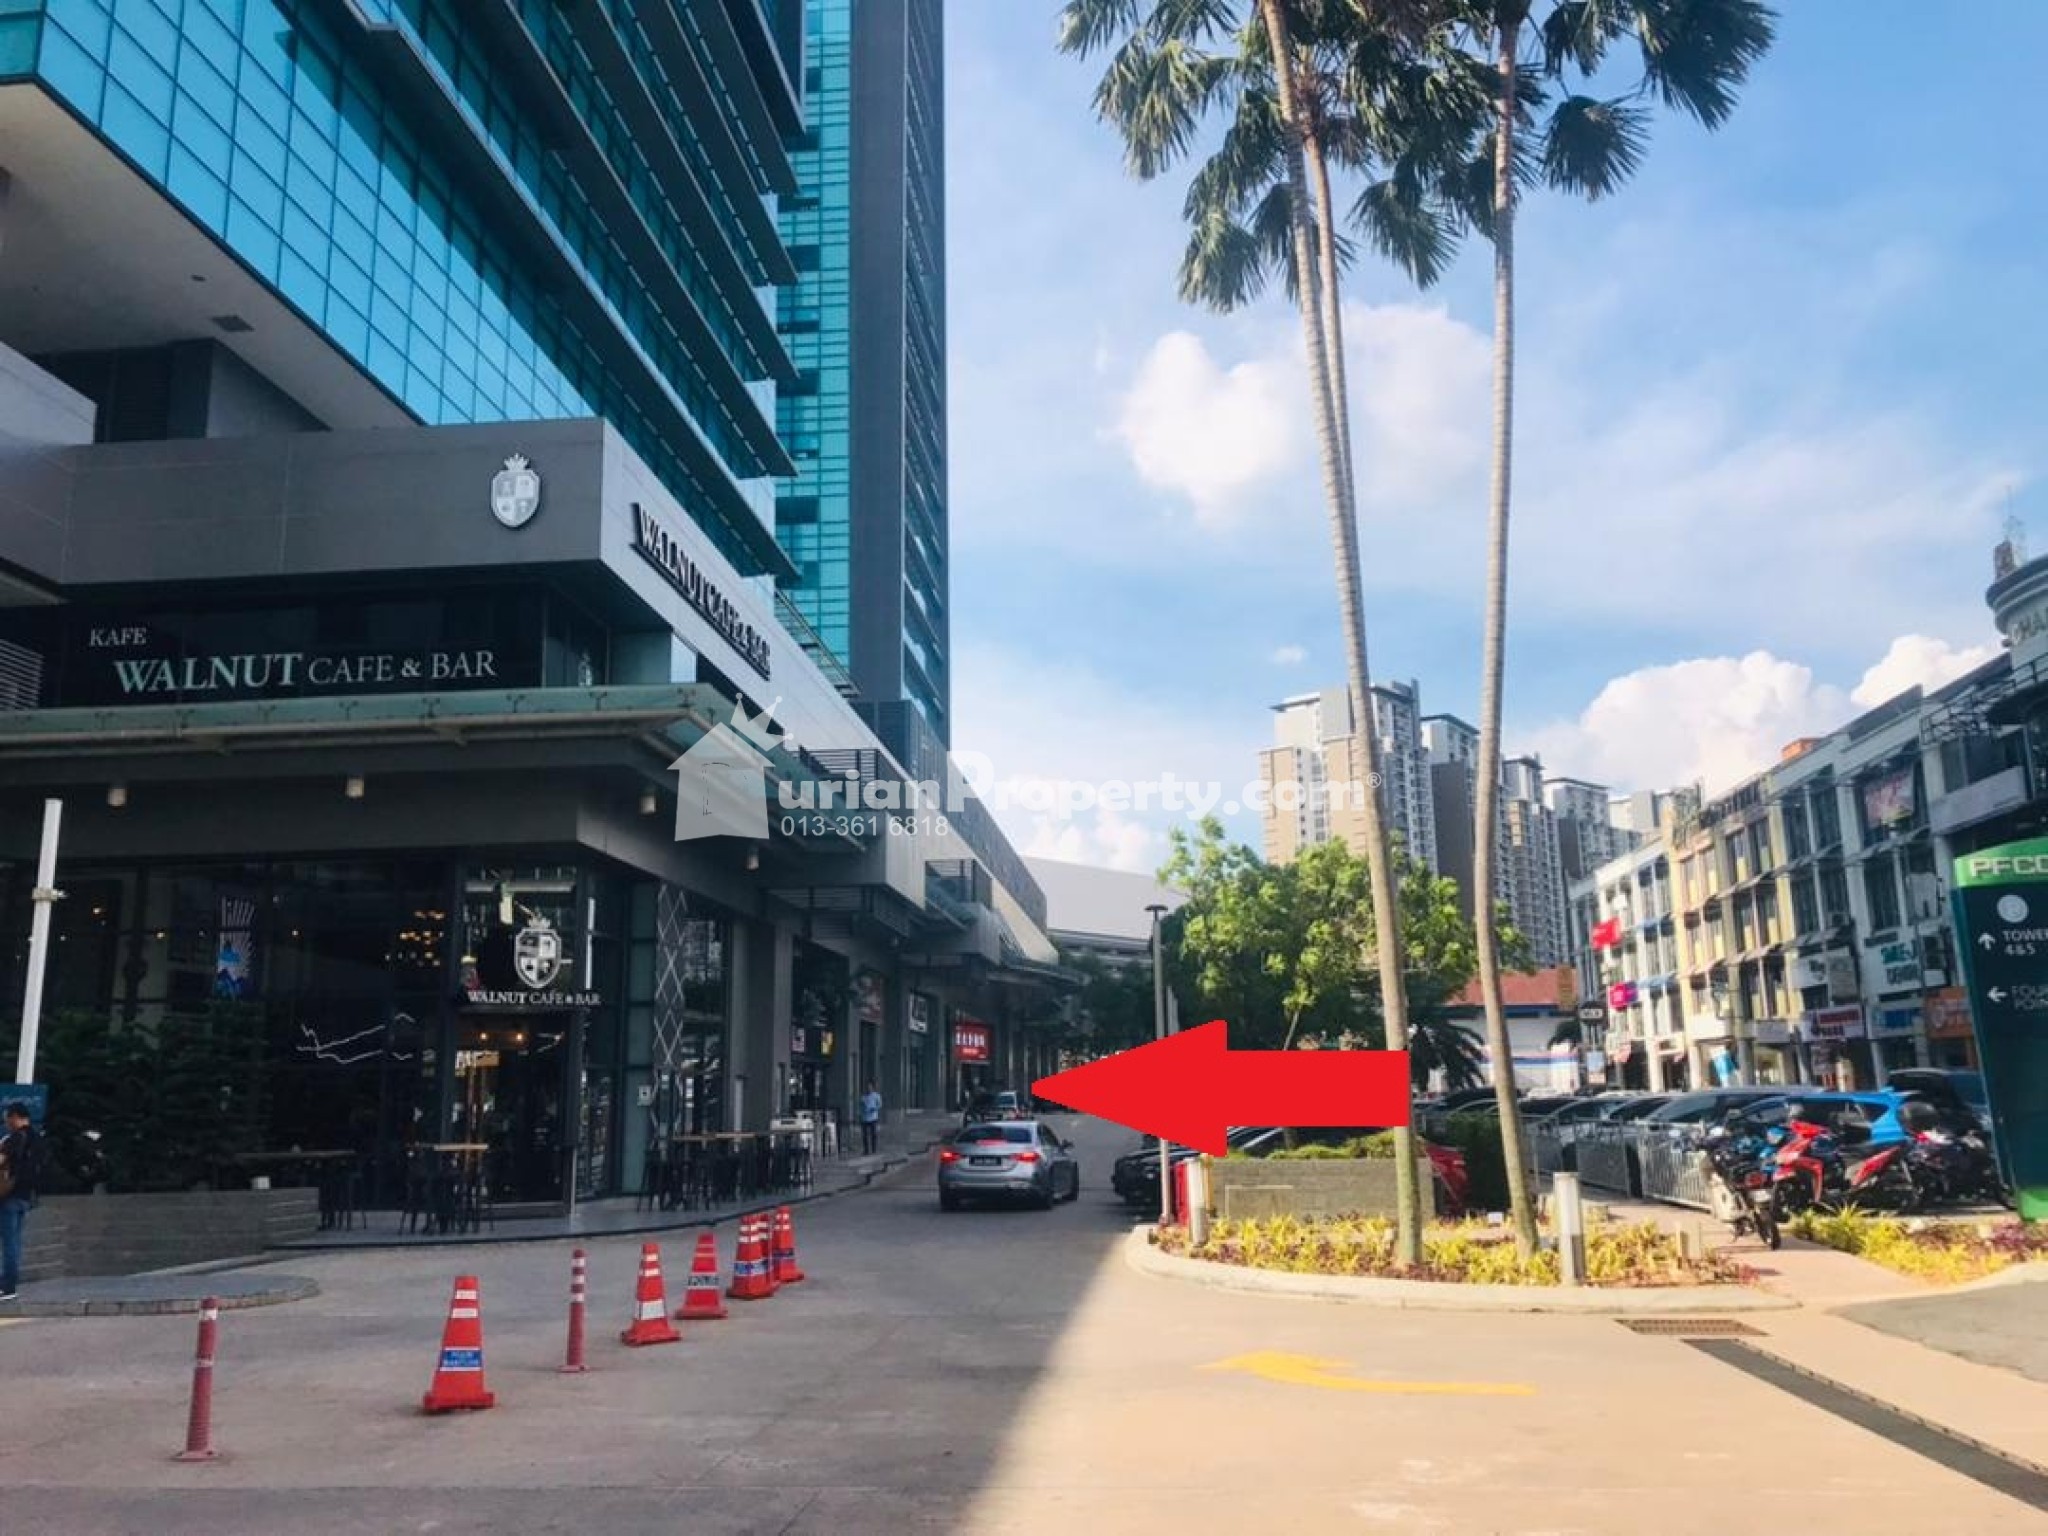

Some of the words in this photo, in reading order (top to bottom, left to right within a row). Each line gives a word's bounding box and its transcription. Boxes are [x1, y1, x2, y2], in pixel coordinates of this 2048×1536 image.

[89, 627, 147, 647] KAFE
[114, 653, 303, 693] WALNUT
[308, 655, 394, 684] CAFE
[400, 657, 422, 678] &
[430, 650, 498, 679] BAR
[467, 991, 527, 1004] WALNUT
[529, 992, 564, 1005] CAFE
